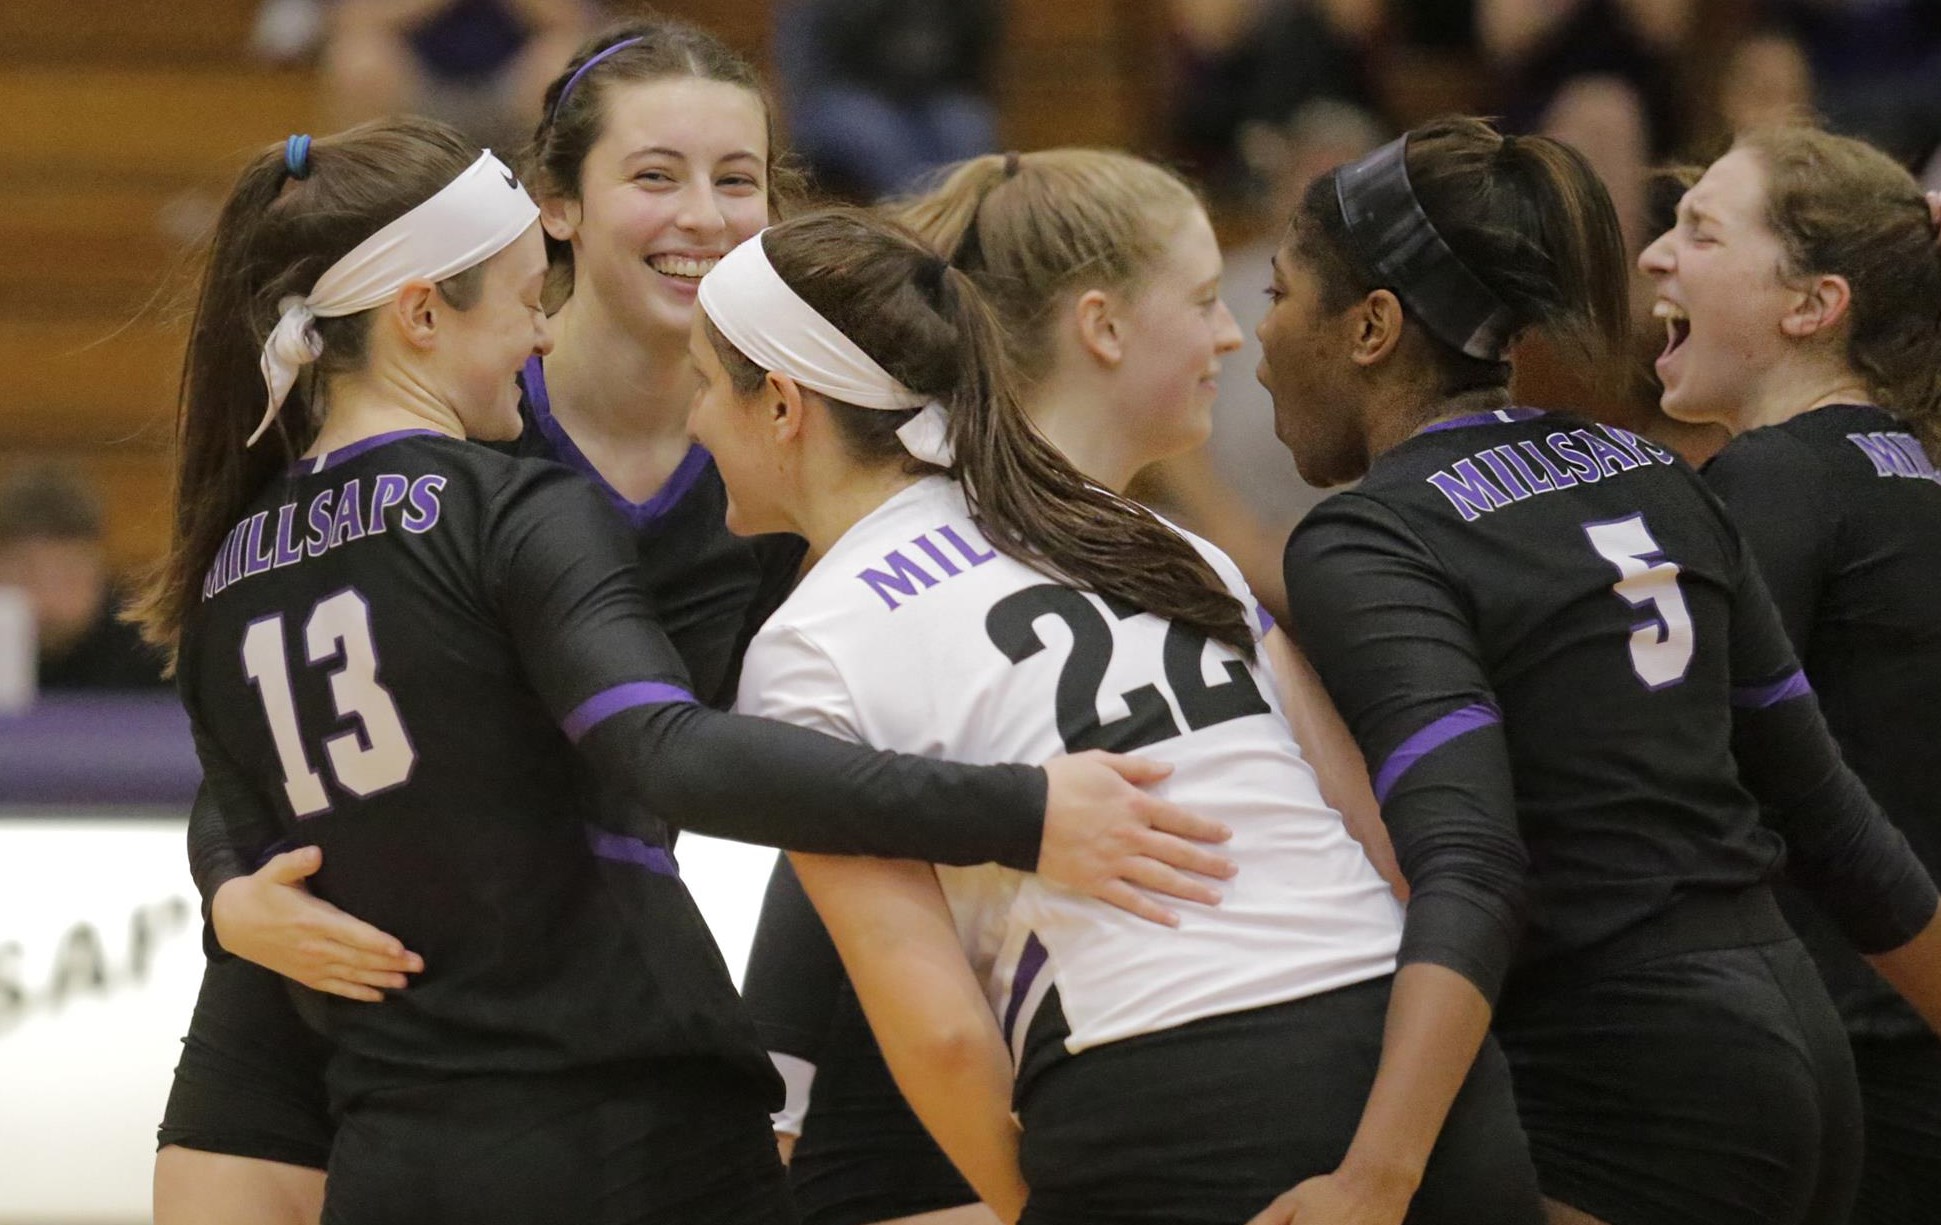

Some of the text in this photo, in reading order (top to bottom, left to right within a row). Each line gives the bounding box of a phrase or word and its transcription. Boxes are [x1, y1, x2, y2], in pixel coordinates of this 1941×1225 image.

[985, 583, 1272, 754] 22
[1581, 511, 1695, 692] 5
[239, 586, 419, 820] 13
